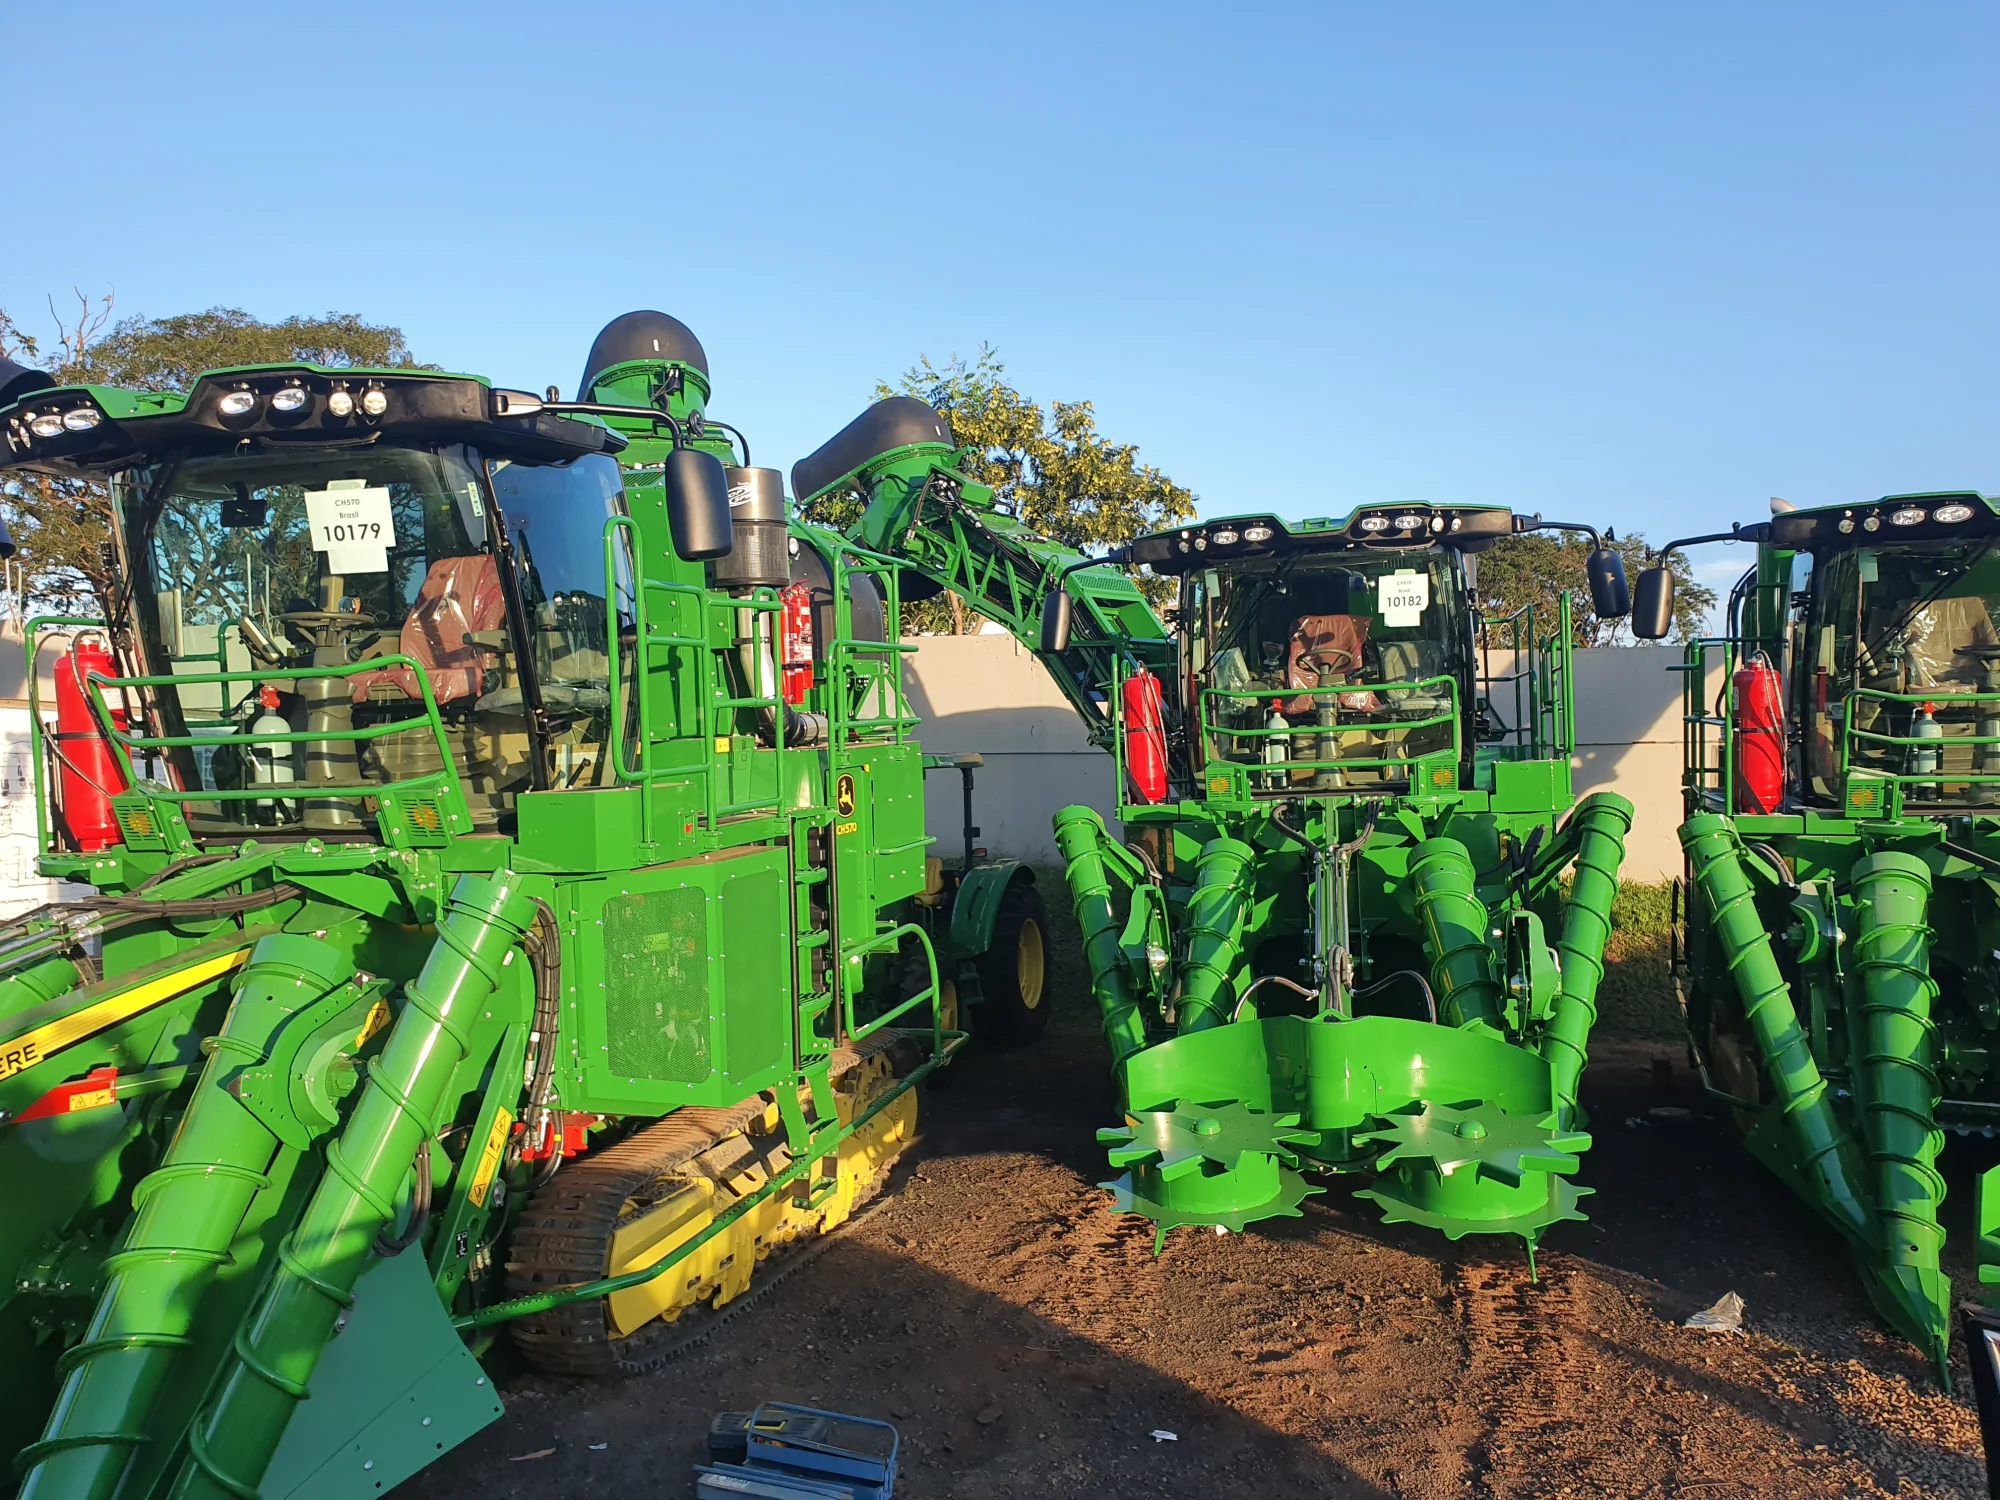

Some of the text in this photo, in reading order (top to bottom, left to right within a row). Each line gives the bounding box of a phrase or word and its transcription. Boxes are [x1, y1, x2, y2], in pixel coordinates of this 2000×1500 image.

[335, 498, 360, 507] CH570
[339, 511, 359, 519] Brasil
[323, 523, 381, 542] 10179
[1387, 595, 1422, 607] 10182
[836, 822, 857, 835] CH570
